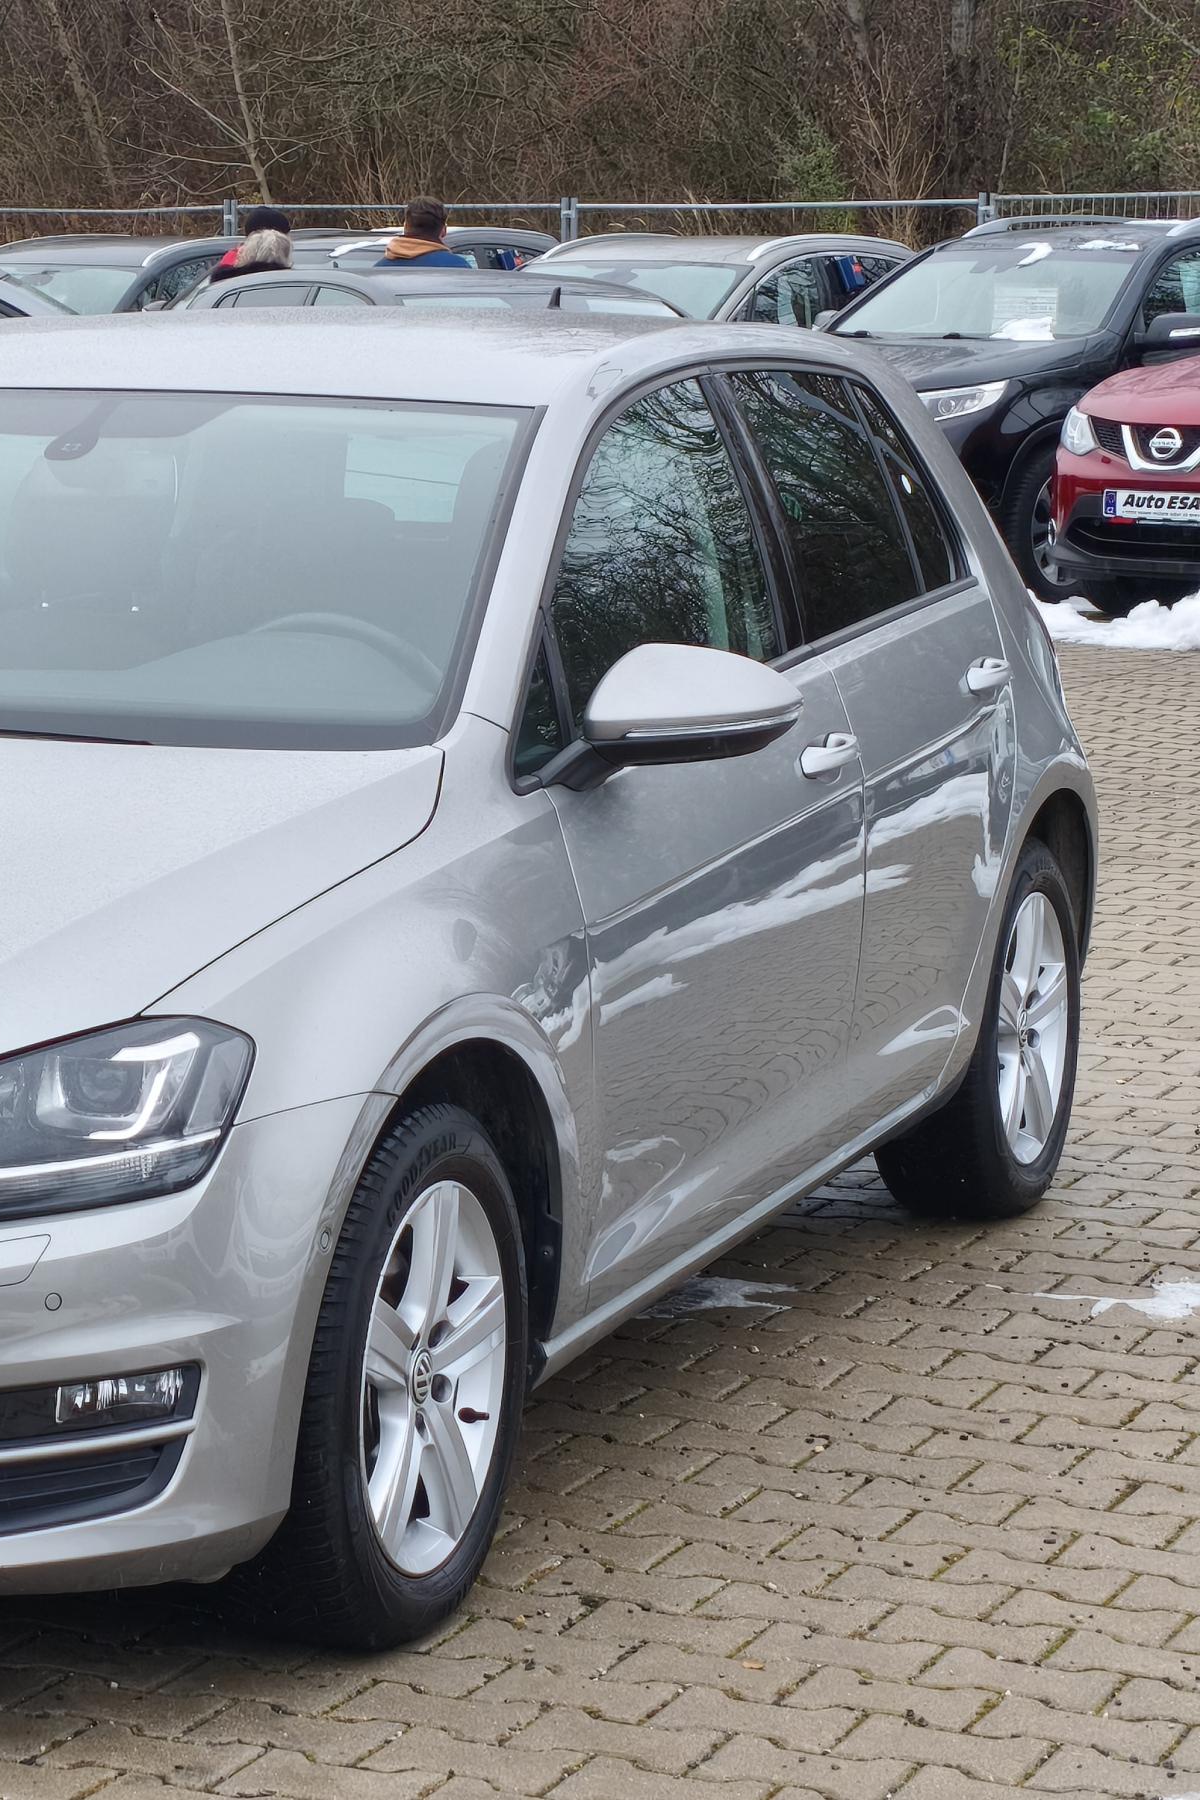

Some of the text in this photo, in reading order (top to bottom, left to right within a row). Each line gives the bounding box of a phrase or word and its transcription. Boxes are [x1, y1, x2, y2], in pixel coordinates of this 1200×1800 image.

[1122, 493, 1200, 510] Auto ESA
[386, 1130, 457, 1229] GOODYEAR
